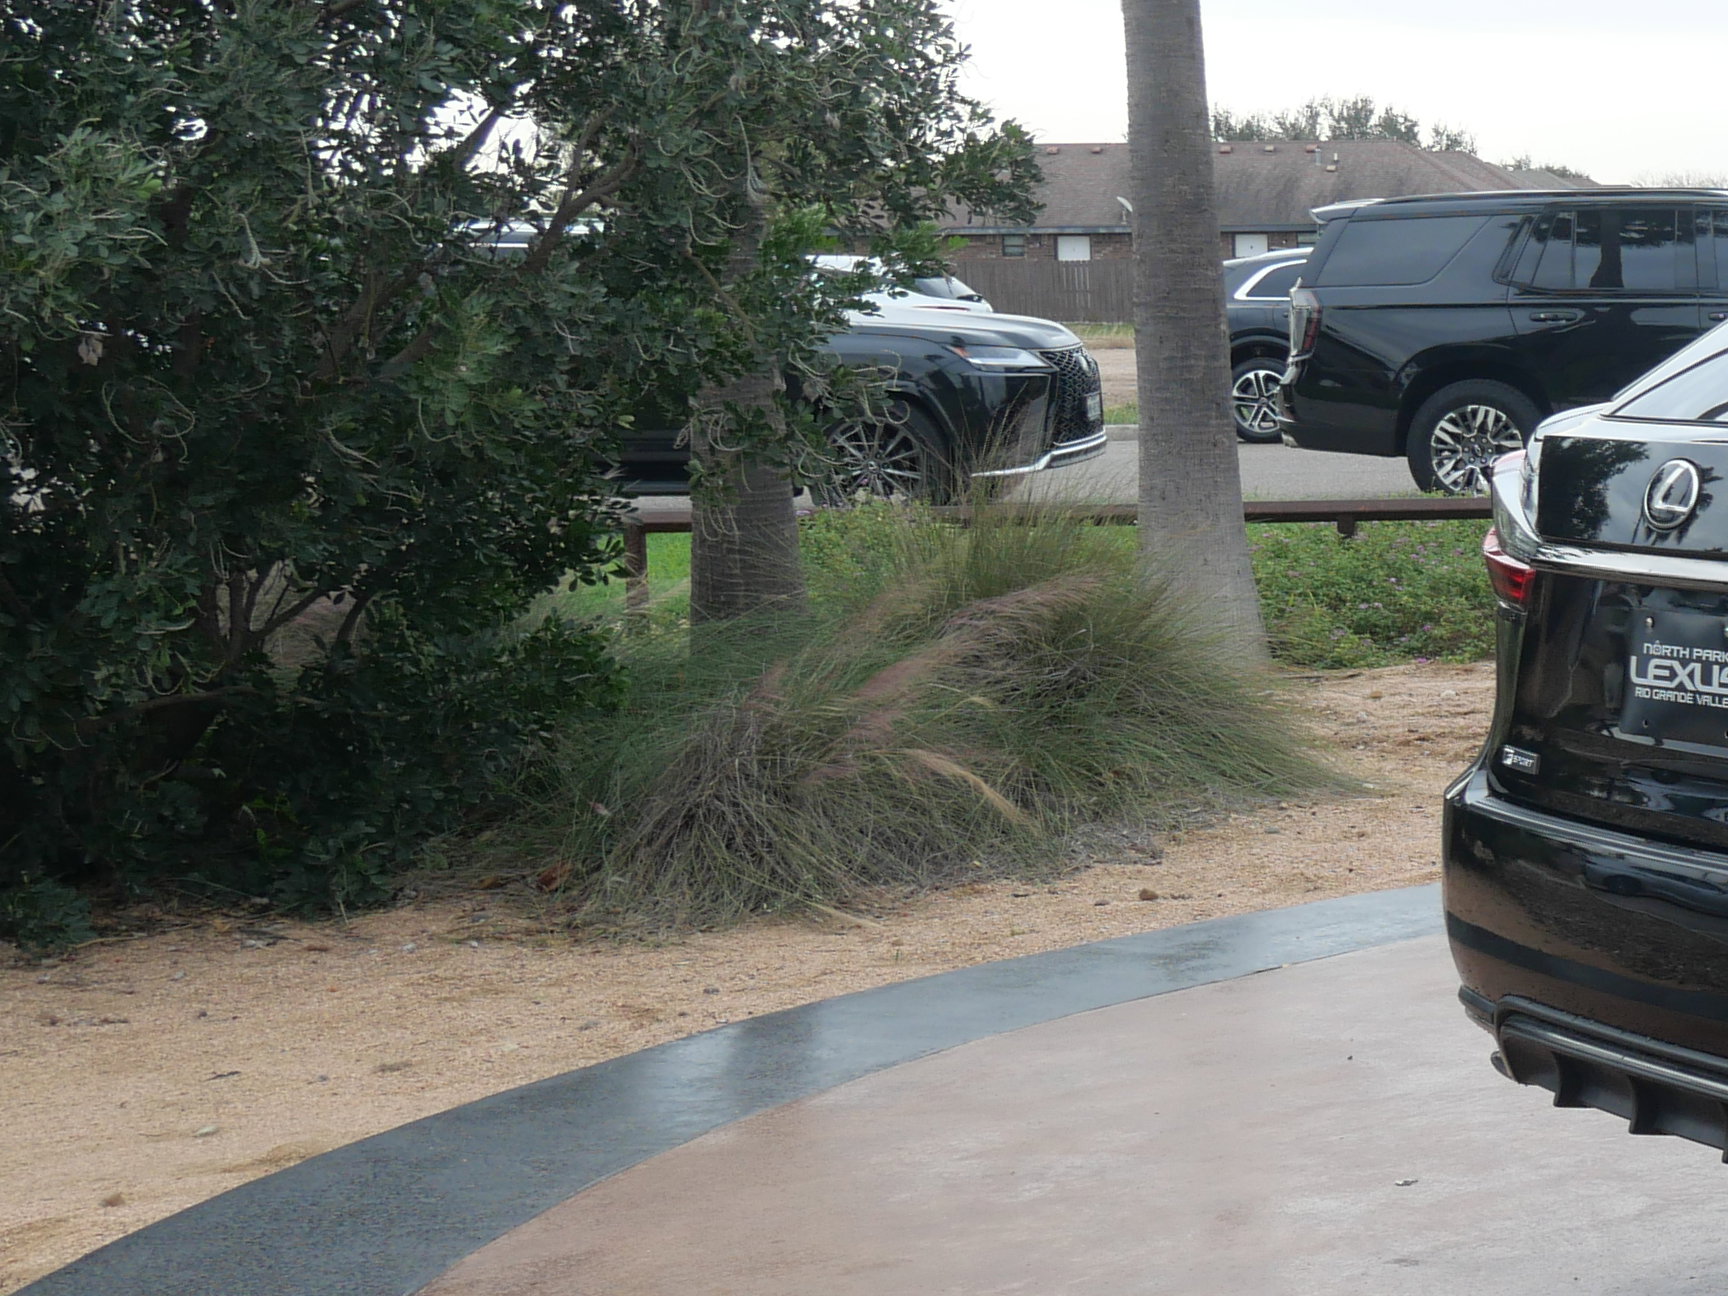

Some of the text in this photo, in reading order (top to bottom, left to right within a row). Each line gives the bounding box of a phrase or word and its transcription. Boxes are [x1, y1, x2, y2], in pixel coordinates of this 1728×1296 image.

[1643, 641, 1690, 659] NORTH
[1635, 686, 1651, 698] RIO
[1652, 689, 1694, 704] GRANDE
